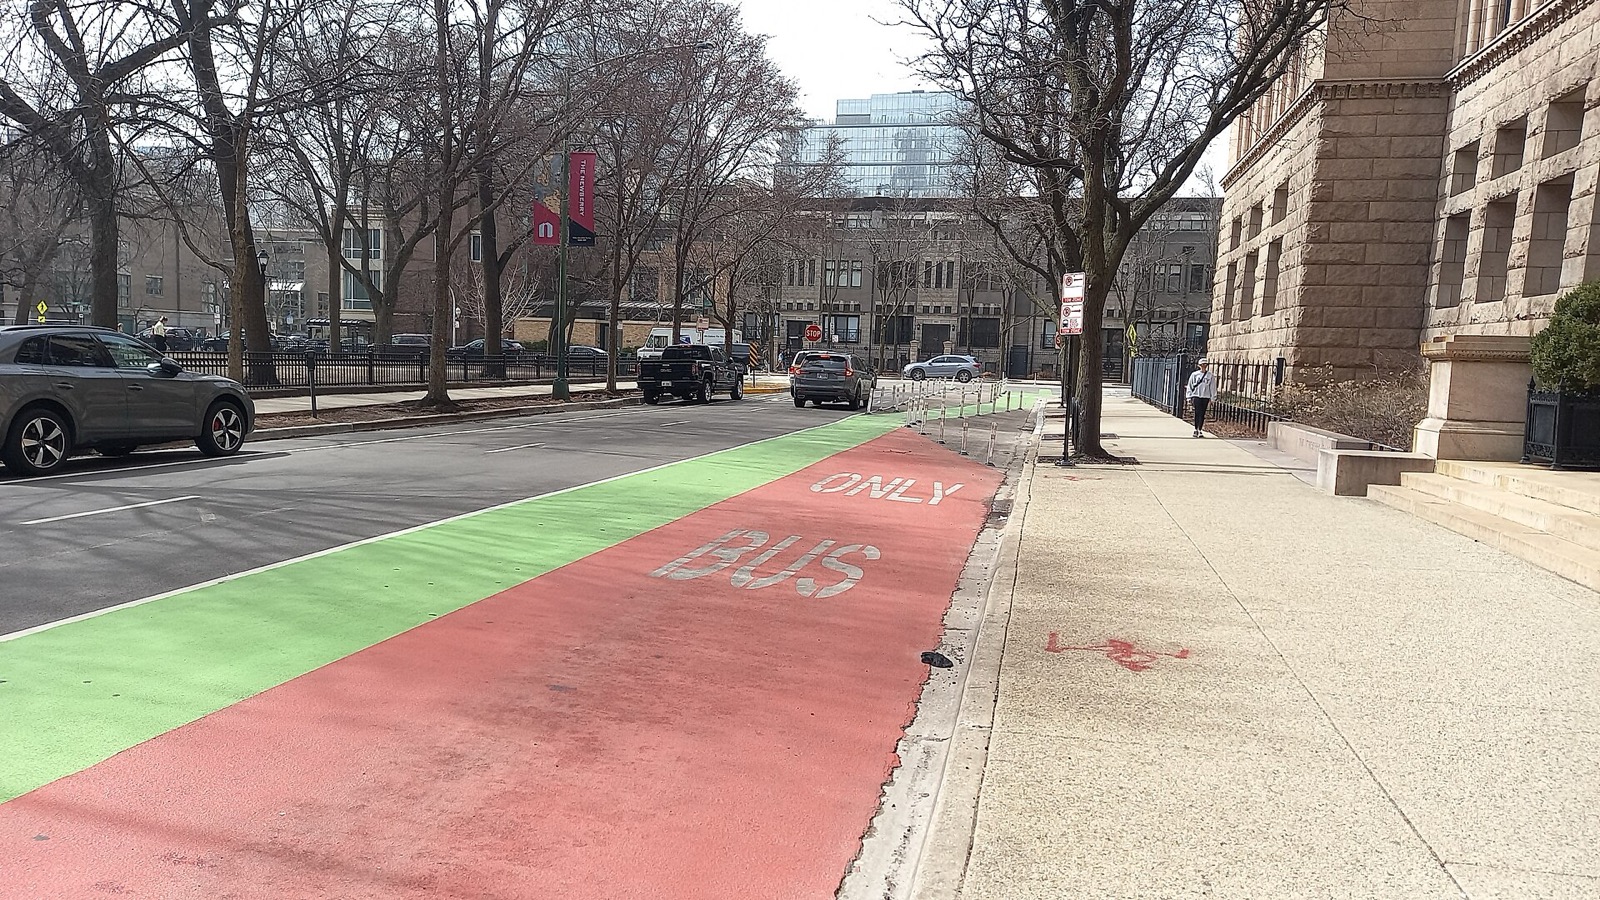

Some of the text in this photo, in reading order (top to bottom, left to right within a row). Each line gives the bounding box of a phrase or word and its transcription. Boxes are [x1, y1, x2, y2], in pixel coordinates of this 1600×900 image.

[806, 330, 821, 338] STOP
[809, 472, 964, 505] ONLY
[650, 528, 882, 599] BUS
